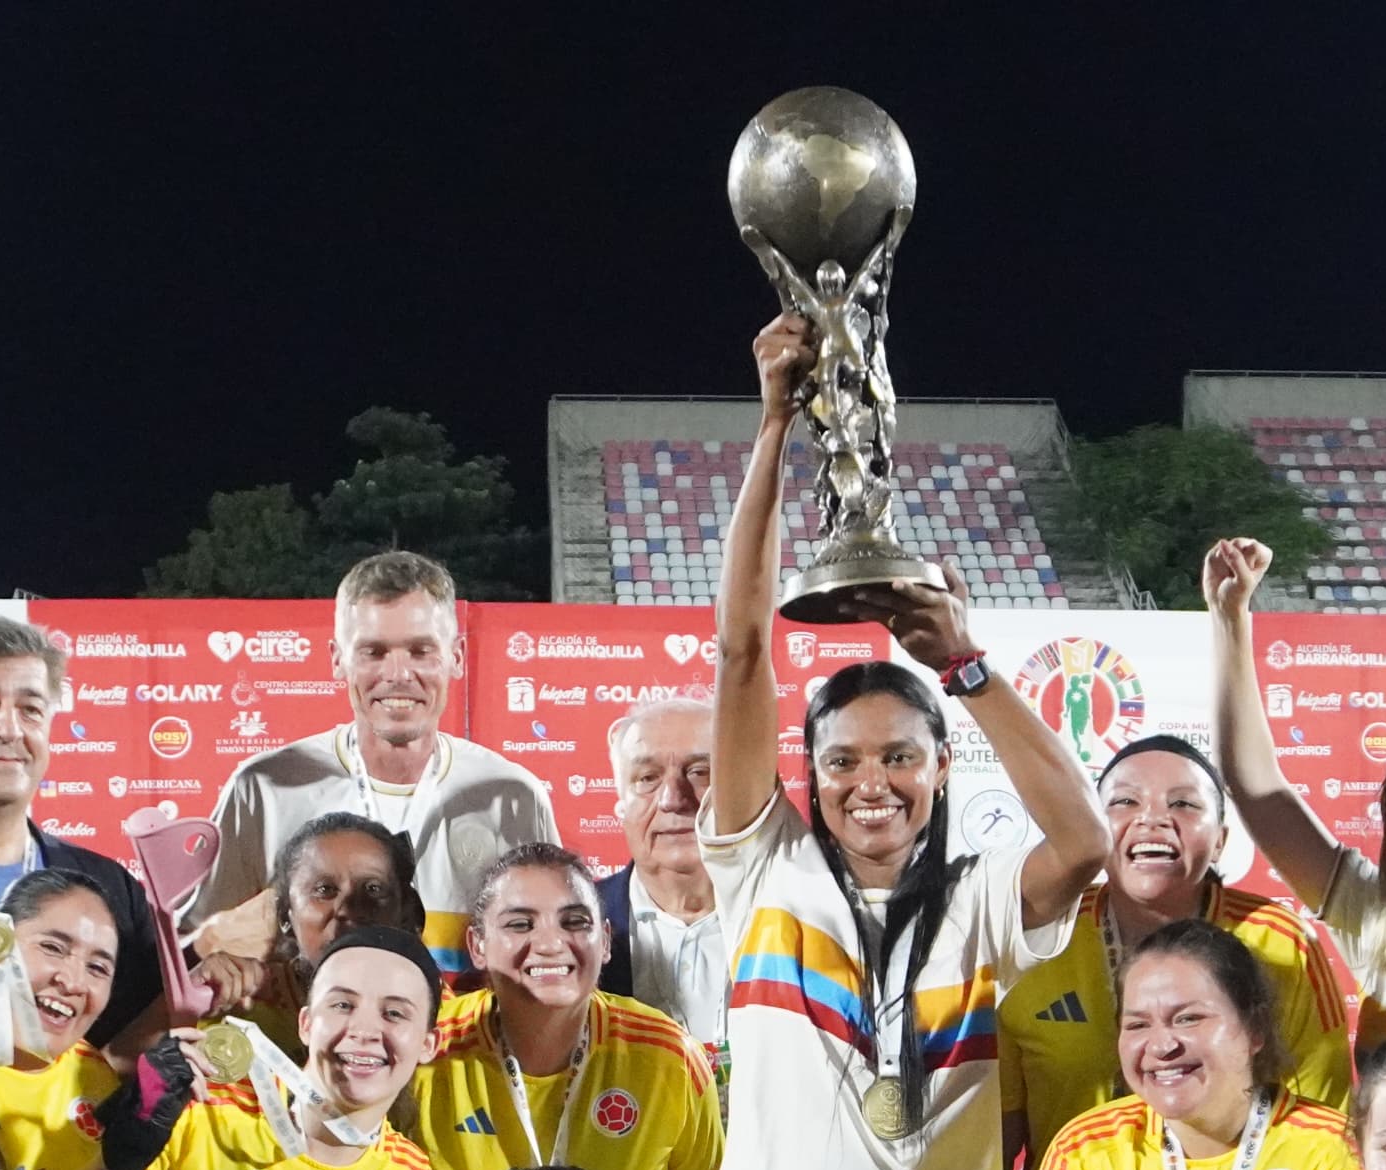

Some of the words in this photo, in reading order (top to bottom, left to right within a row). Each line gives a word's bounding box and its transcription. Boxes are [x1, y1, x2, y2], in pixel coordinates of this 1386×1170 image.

[77, 633, 123, 643] ALCALDÍA
[126, 635, 138, 643] DE
[538, 635, 582, 645] ALCALDÍA
[586, 636, 597, 645] DE
[76, 644, 186, 657] BARRANQUILLA
[245, 637, 311, 658] cirec
[538, 645, 644, 658] BARRANQUILLA
[1296, 642, 1338, 653] ALCALDÍA
[1340, 645, 1352, 653] DE
[254, 681, 289, 689] CENTRO
[136, 685, 222, 702] GOLARY
[595, 685, 677, 703] GOLARY
[153, 731, 188, 744] easy
[49, 741, 117, 754] uperGIROS
[129, 779, 202, 790] AMERICANA
